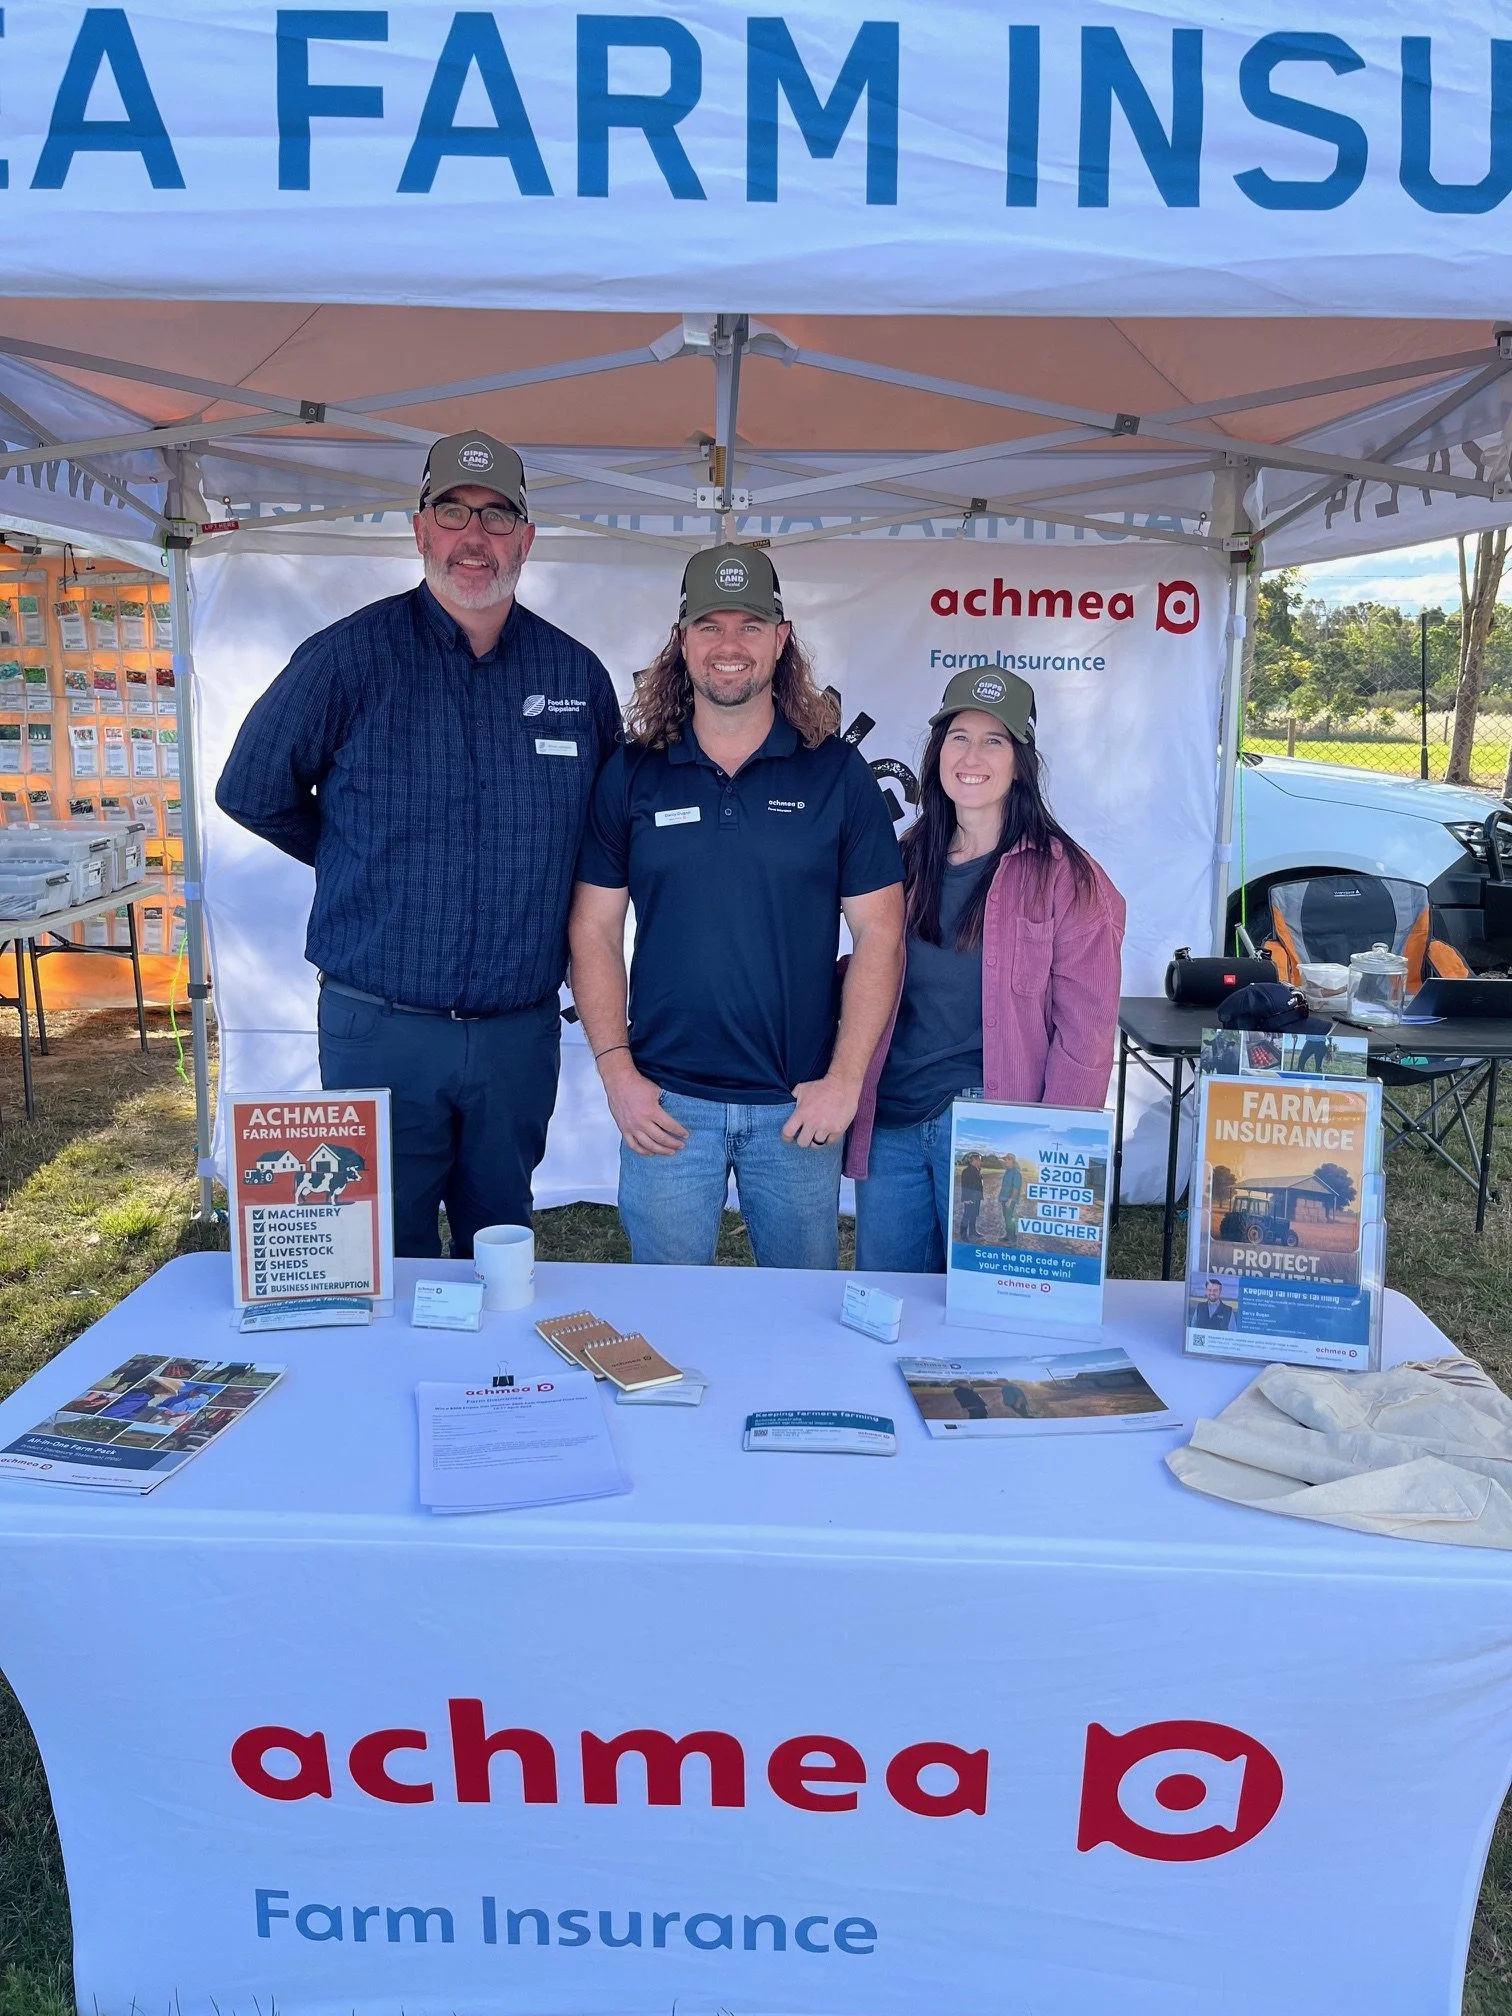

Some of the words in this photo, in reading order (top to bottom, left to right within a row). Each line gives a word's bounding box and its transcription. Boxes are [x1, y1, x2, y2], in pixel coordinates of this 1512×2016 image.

[0, 8, 186, 190] A
[276, 9, 899, 205] FARM
[1001, 22, 1512, 214] INSU
[462, 455, 488, 465] LAND
[463, 450, 489, 459] GIPPS
[720, 568, 744, 576] GIPPS
[930, 577, 1134, 621] achmea
[930, 649, 988, 669] Farm
[995, 650, 1106, 671] Insurance
[976, 687, 1001, 697] LAND
[978, 681, 1003, 691] GIPPS
[547, 705, 580, 713] Gippsland
[768, 799, 796, 807] achmea
[1242, 1090, 1331, 1124] FARM
[249, 1105, 360, 1126] ACHMEA
[243, 1128, 281, 1140] FARM
[286, 1125, 366, 1139] INSURANCE
[1215, 1119, 1355, 1151] INSURANCE
[1039, 1150, 1069, 1165] WIN
[1074, 1154, 1086, 1166] A
[1041, 1166, 1082, 1183] $200
[1028, 1186, 1092, 1203] EFTPOS
[268, 1207, 341, 1220] MACHINERY
[1041, 1204, 1078, 1219] GIFT
[268, 1221, 317, 1233] HOUSES
[1020, 1219, 1097, 1240] VOUCHER
[269, 1233, 332, 1245] CONTENTS
[269, 1246, 334, 1258] LIVESTOCK
[975, 1249, 999, 1260] Scan
[1001, 1252, 1017, 1261] the
[1019, 1254, 1033, 1264] QR
[1035, 1256, 1059, 1267] code
[1061, 1258, 1076, 1268] for
[270, 1259, 309, 1270] SHEDS
[1232, 1248, 1320, 1274] PROTECT
[270, 1270, 326, 1282] VEHICLES
[978, 1261, 1000, 1270] your
[1002, 1263, 1037, 1275] chance
[1039, 1266, 1049, 1276] to
[1051, 1269, 1071, 1278] win!
[270, 1283, 309, 1293] BUSINESS
[310, 1280, 370, 1291] INTERRUPTION
[997, 1279, 1037, 1290] achmea
[1315, 1346, 1347, 1356] achmea
[465, 1385, 531, 1396] achmea
[840, 1411, 879, 1422] farming
[70, 1442, 93, 1452] Farm
[94, 1447, 117, 1455] Pack
[231, 1697, 990, 1819] achmea
[254, 1887, 456, 1945] Farm
[480, 1894, 879, 1955] Insurance
